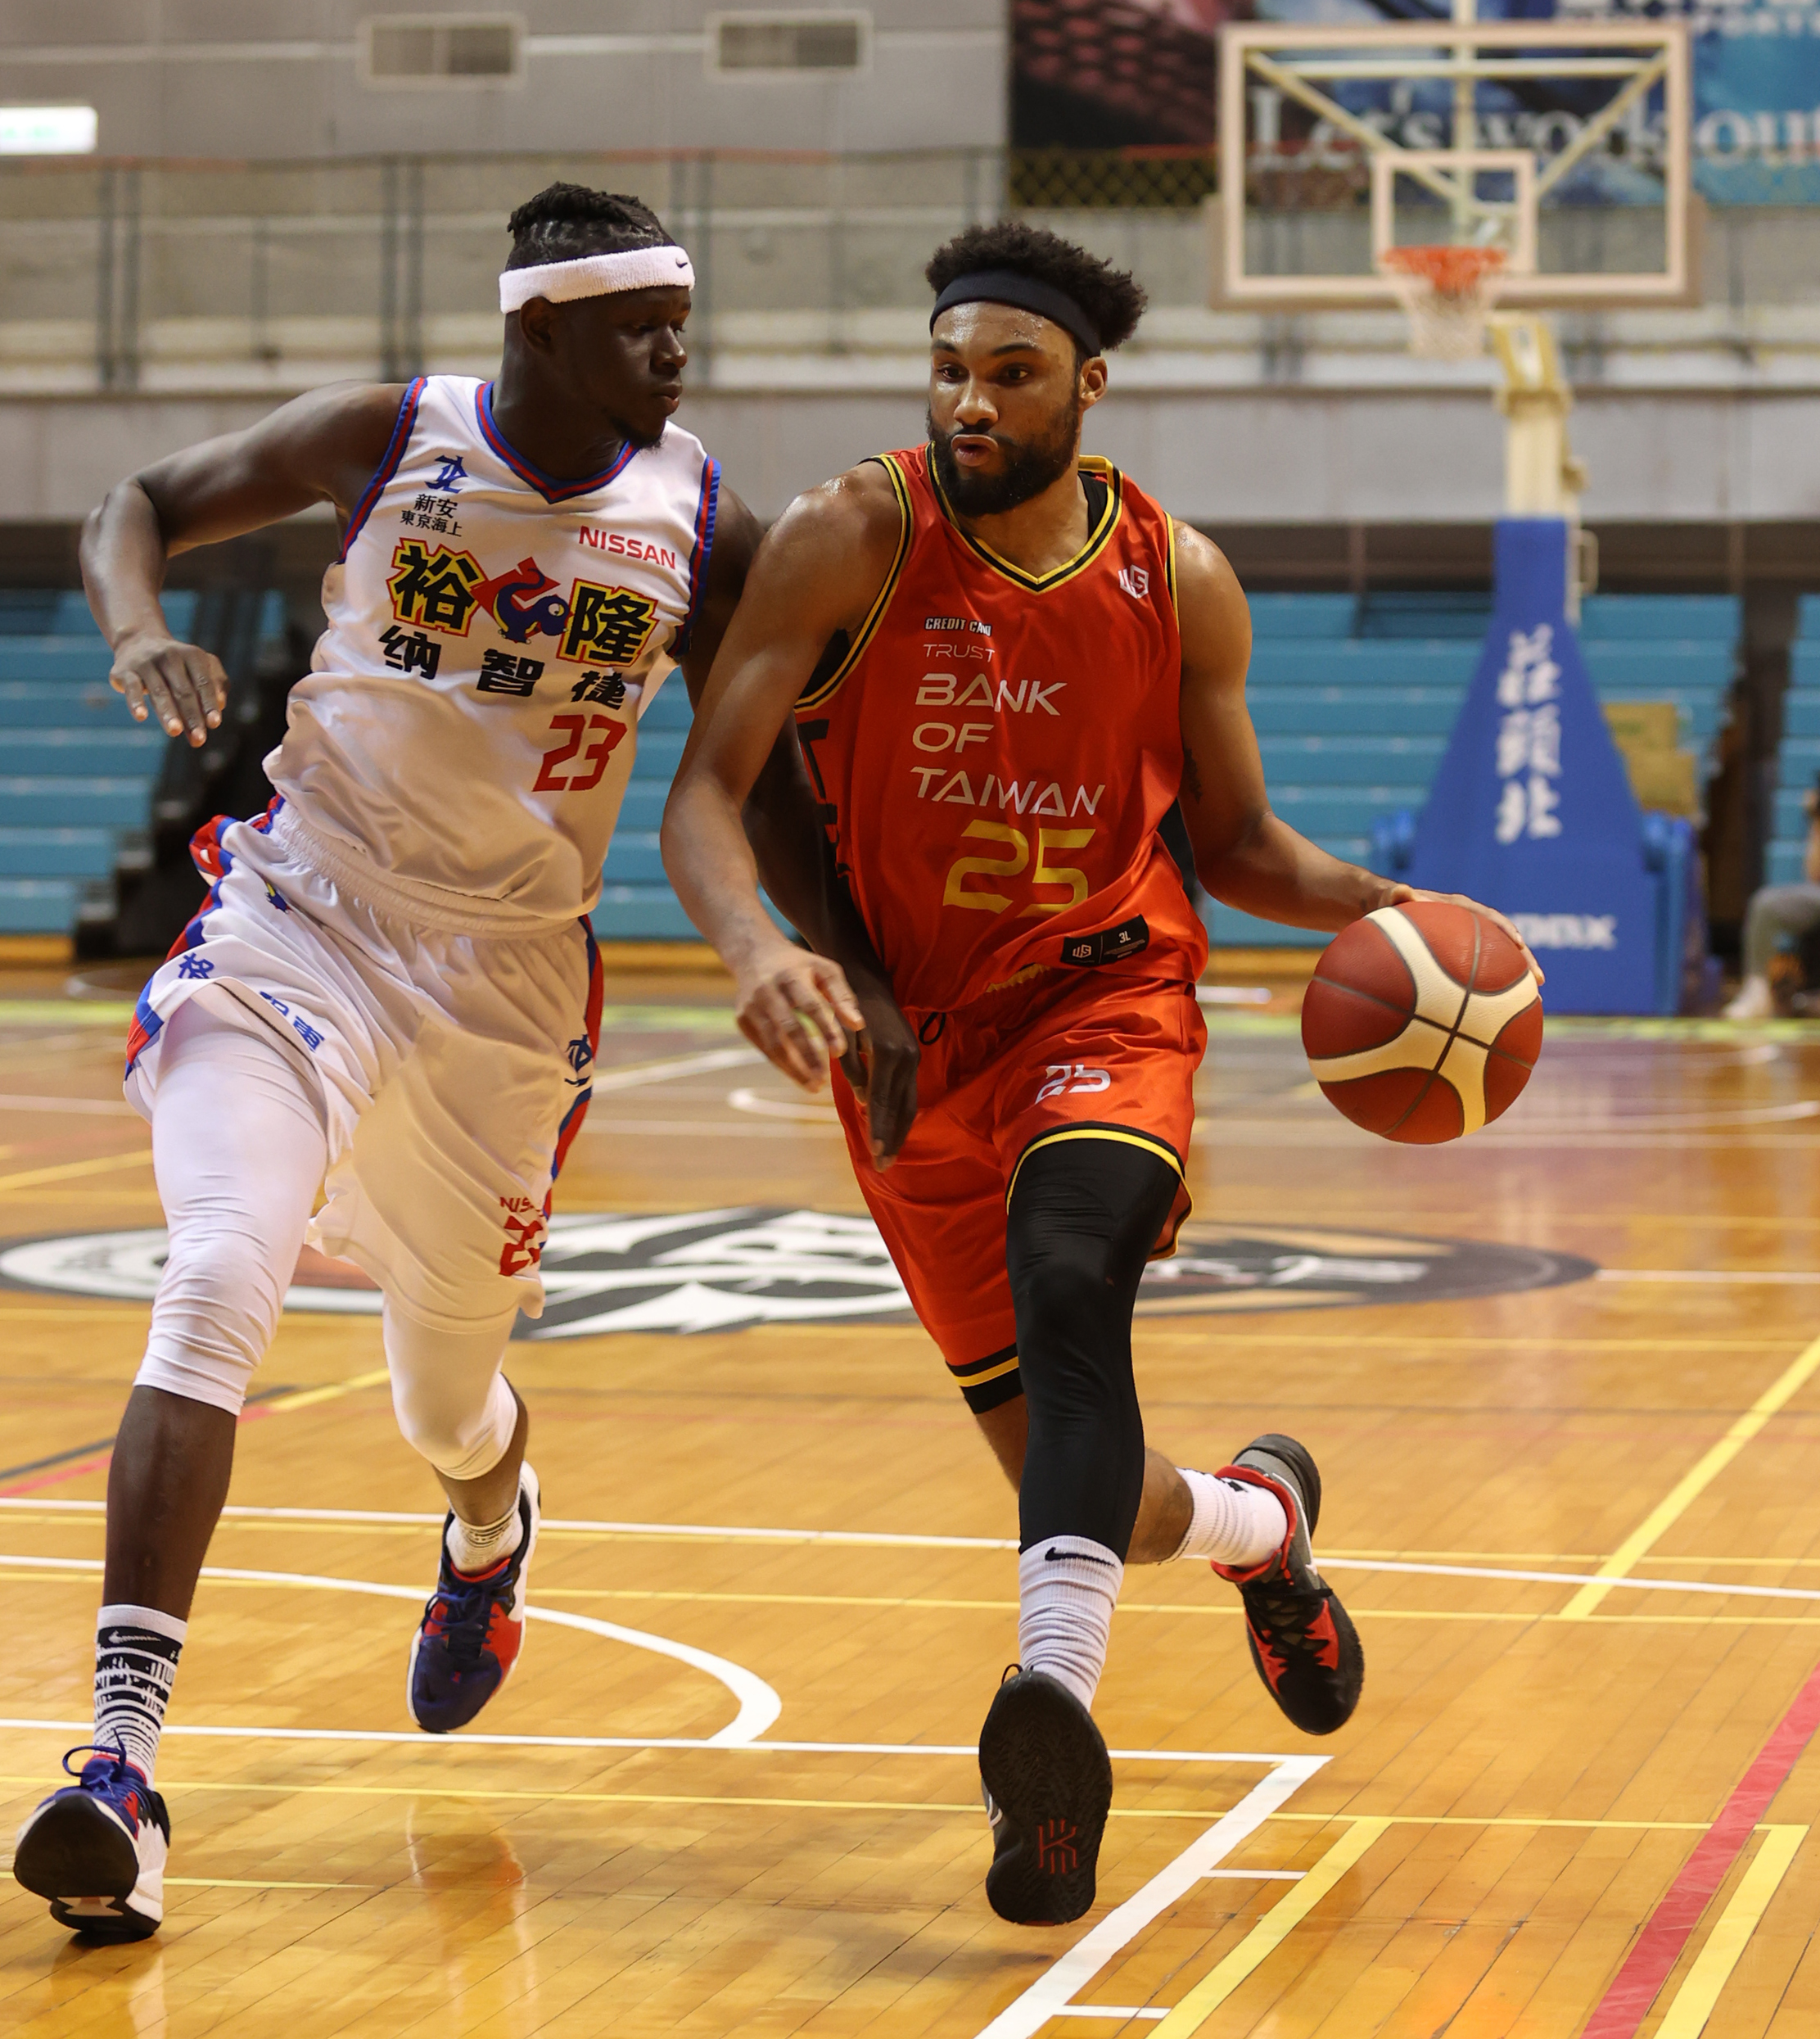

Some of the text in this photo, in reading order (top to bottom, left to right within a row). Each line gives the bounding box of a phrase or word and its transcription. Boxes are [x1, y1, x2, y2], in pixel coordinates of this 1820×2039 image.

[1696, 108, 1820, 167] ou
[400, 509, 463, 537] 東京海上
[413, 494, 458, 519] 新安
[579, 526, 676, 570] NISSAN
[924, 617, 967, 631] CREDIT
[923, 644, 996, 663] TRUST
[915, 673, 1068, 717] BANK
[532, 714, 628, 793] 23
[912, 722, 995, 753] OF
[910, 766, 1105, 818] TAIWAN
[942, 819, 1096, 918] 25
[1118, 930, 1131, 943] 3L
[1034, 1064, 1112, 1105] 25
